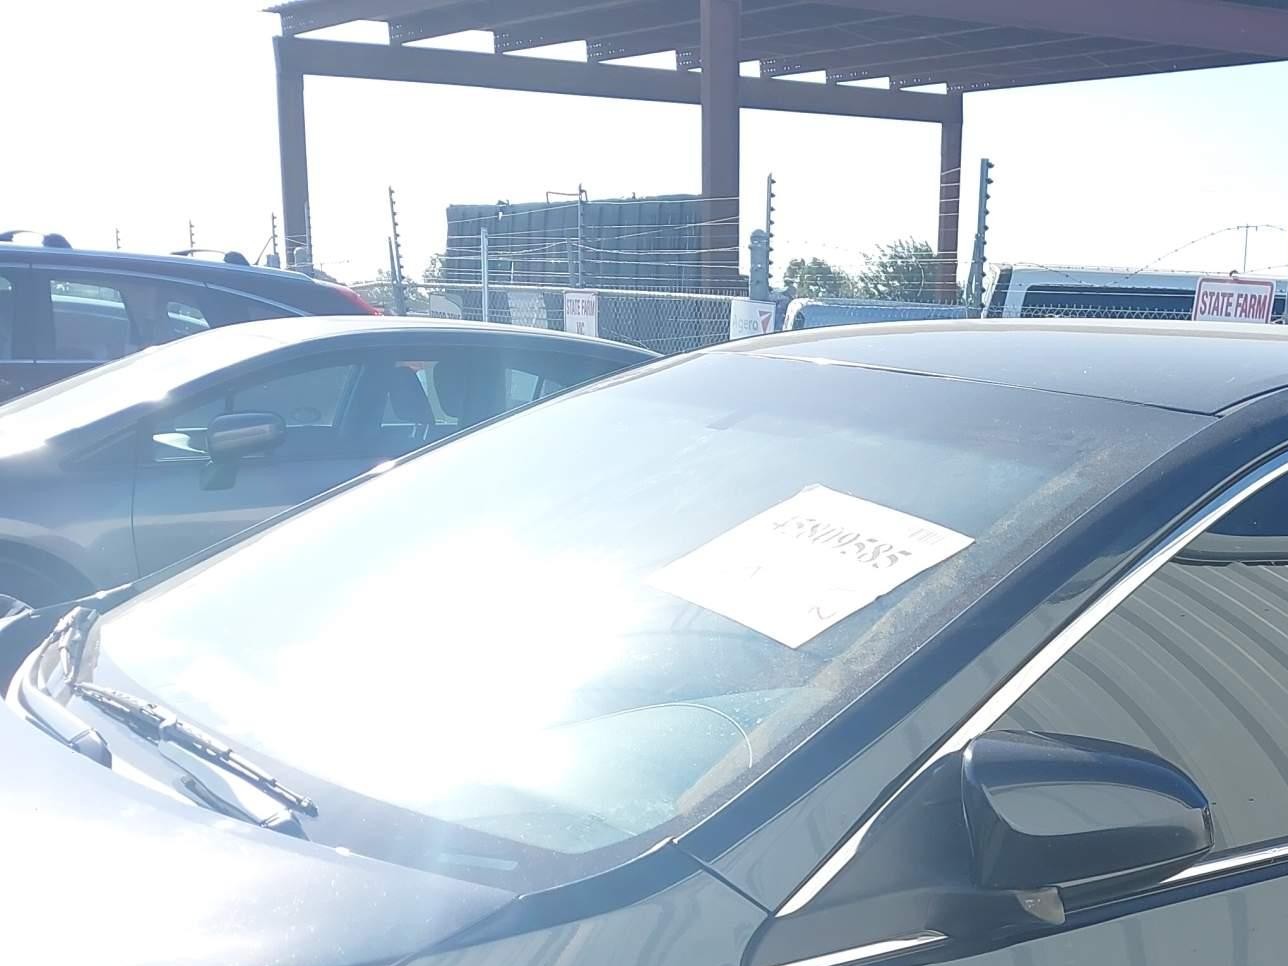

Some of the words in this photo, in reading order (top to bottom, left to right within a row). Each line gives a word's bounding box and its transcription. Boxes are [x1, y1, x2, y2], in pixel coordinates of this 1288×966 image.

[567, 299, 581, 316] STATE
[581, 299, 596, 317] FARM
[1199, 290, 1234, 318] STATE
[1234, 293, 1268, 320] FARM
